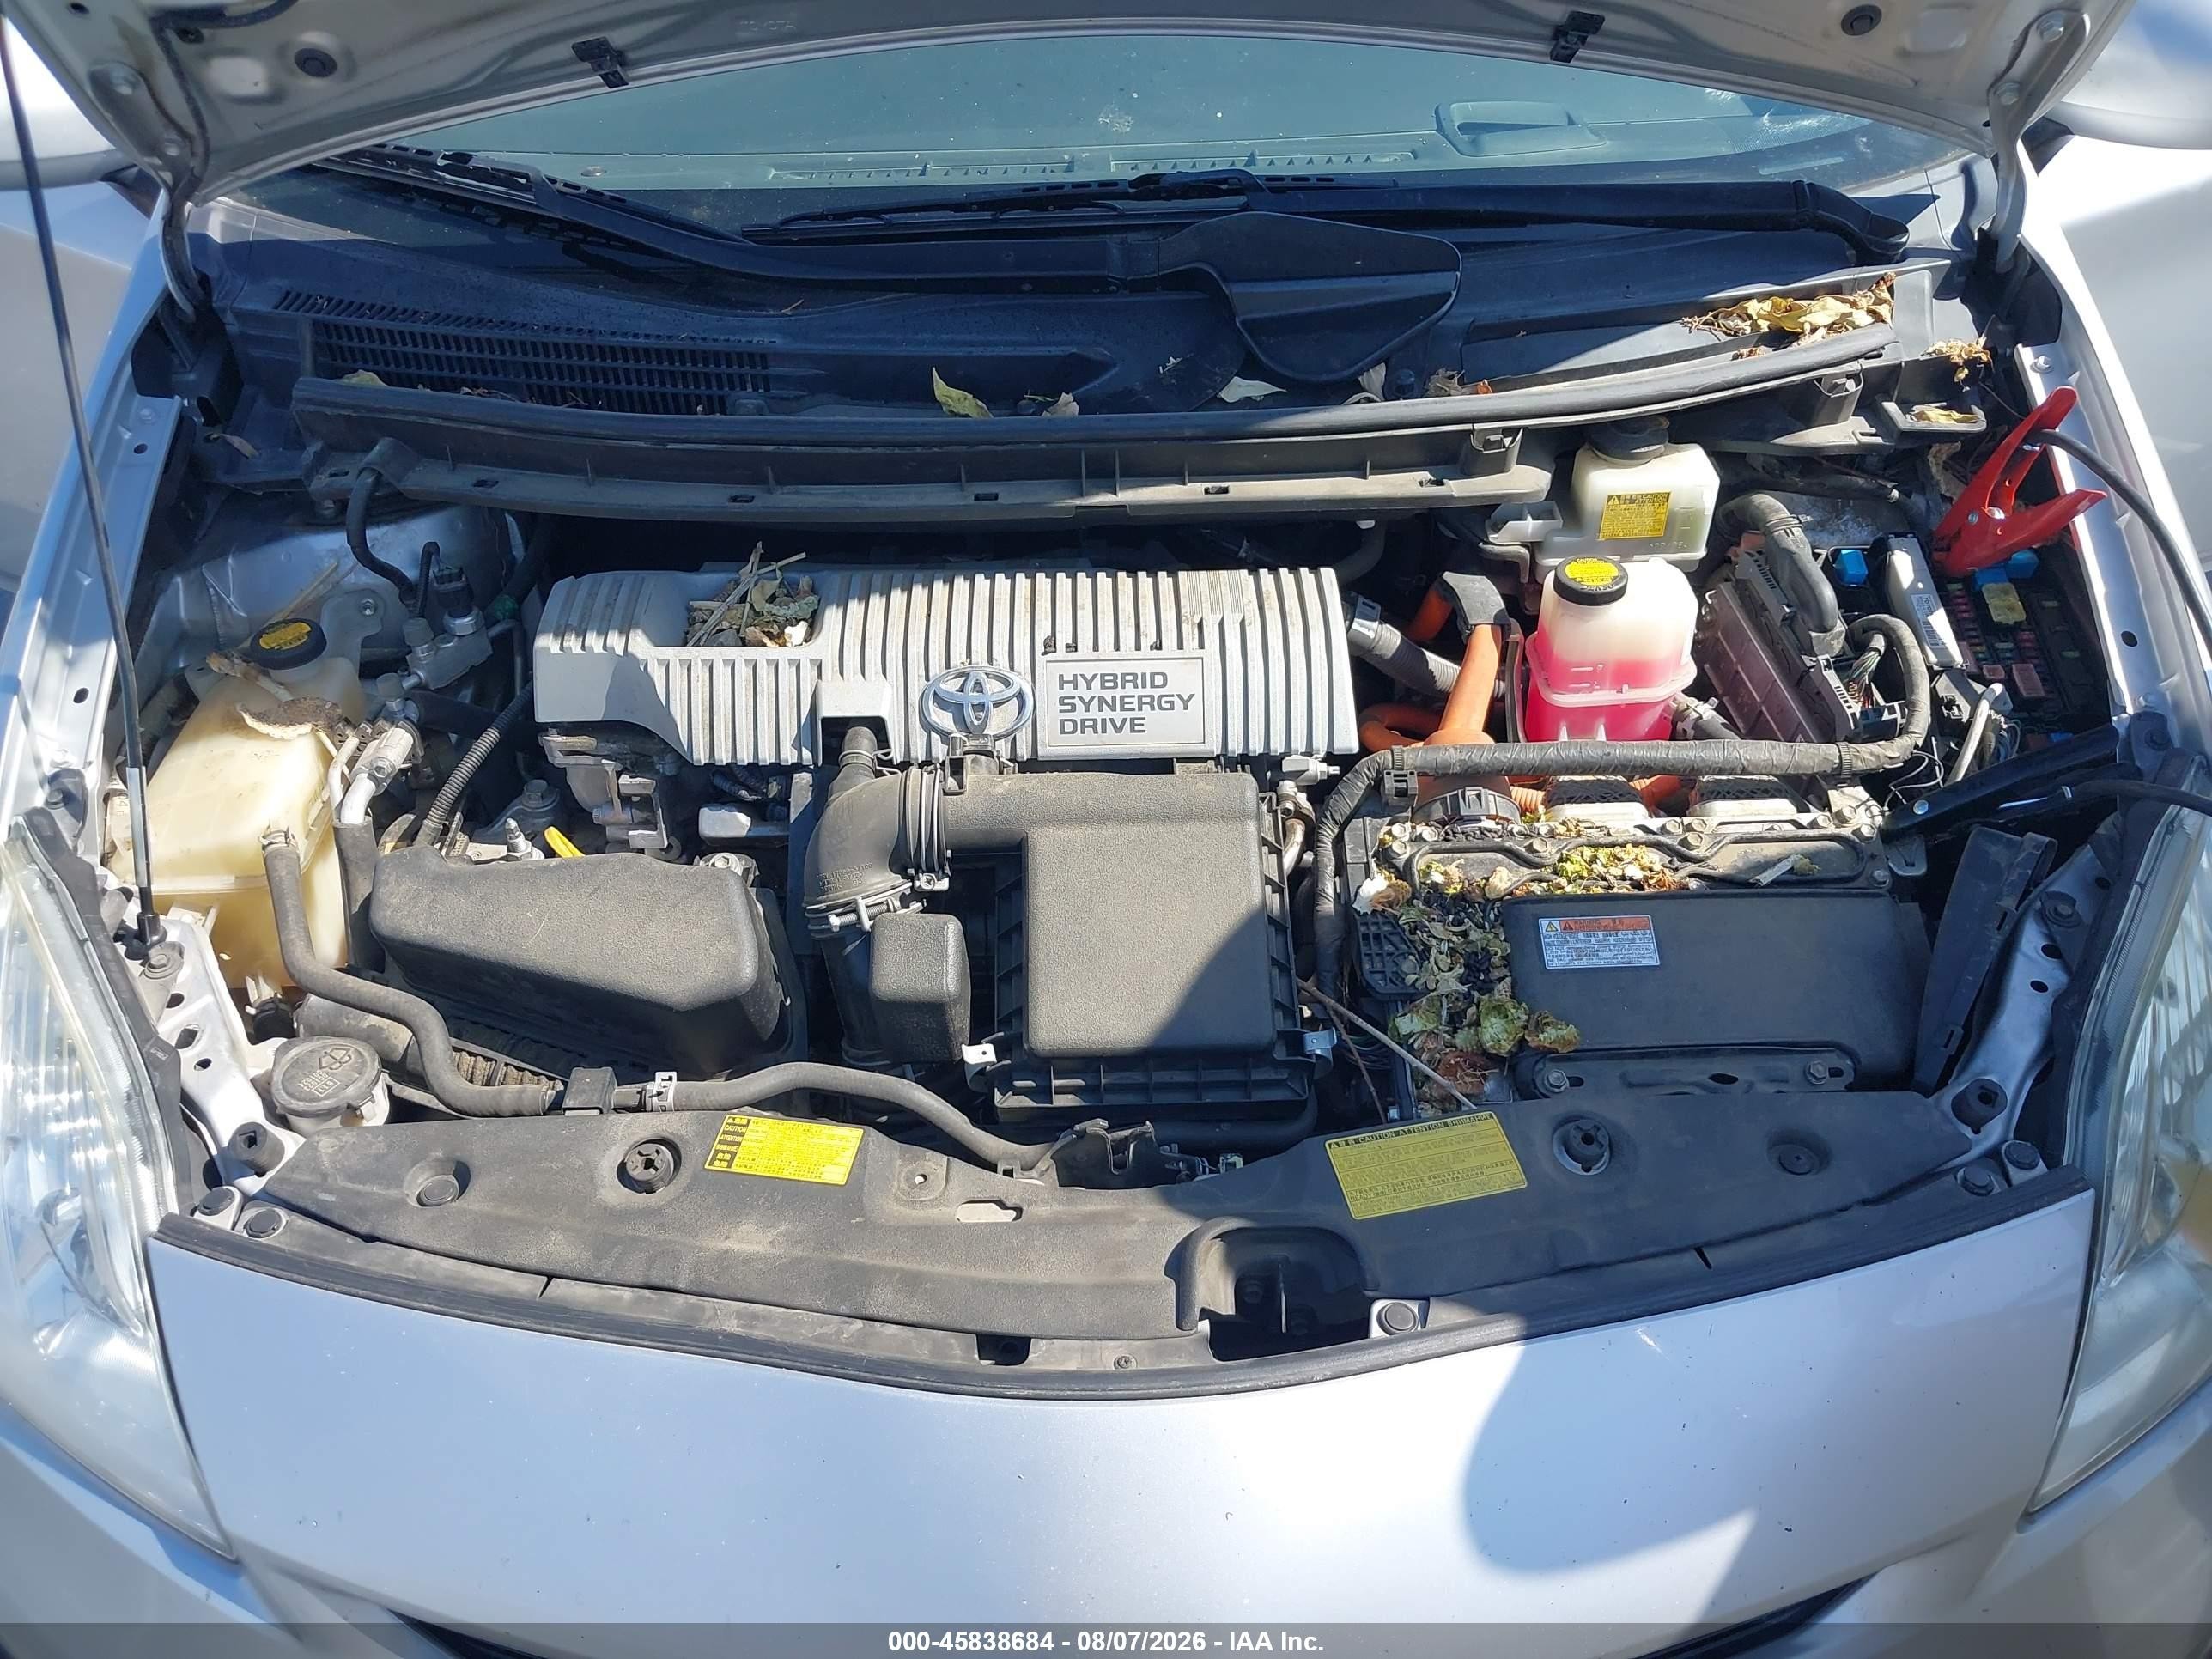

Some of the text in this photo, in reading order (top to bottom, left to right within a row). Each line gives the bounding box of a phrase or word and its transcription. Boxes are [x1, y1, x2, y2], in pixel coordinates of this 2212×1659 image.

[1058, 672, 1169, 691] HYBRID
[1058, 693, 1195, 714] SYNERGY
[1059, 717, 1146, 735] DRIVE
[724, 1124, 748, 1133] CAUTION
[1359, 1131, 1395, 1143] CAUTION
[1399, 1121, 1444, 1136] ATTENTION
